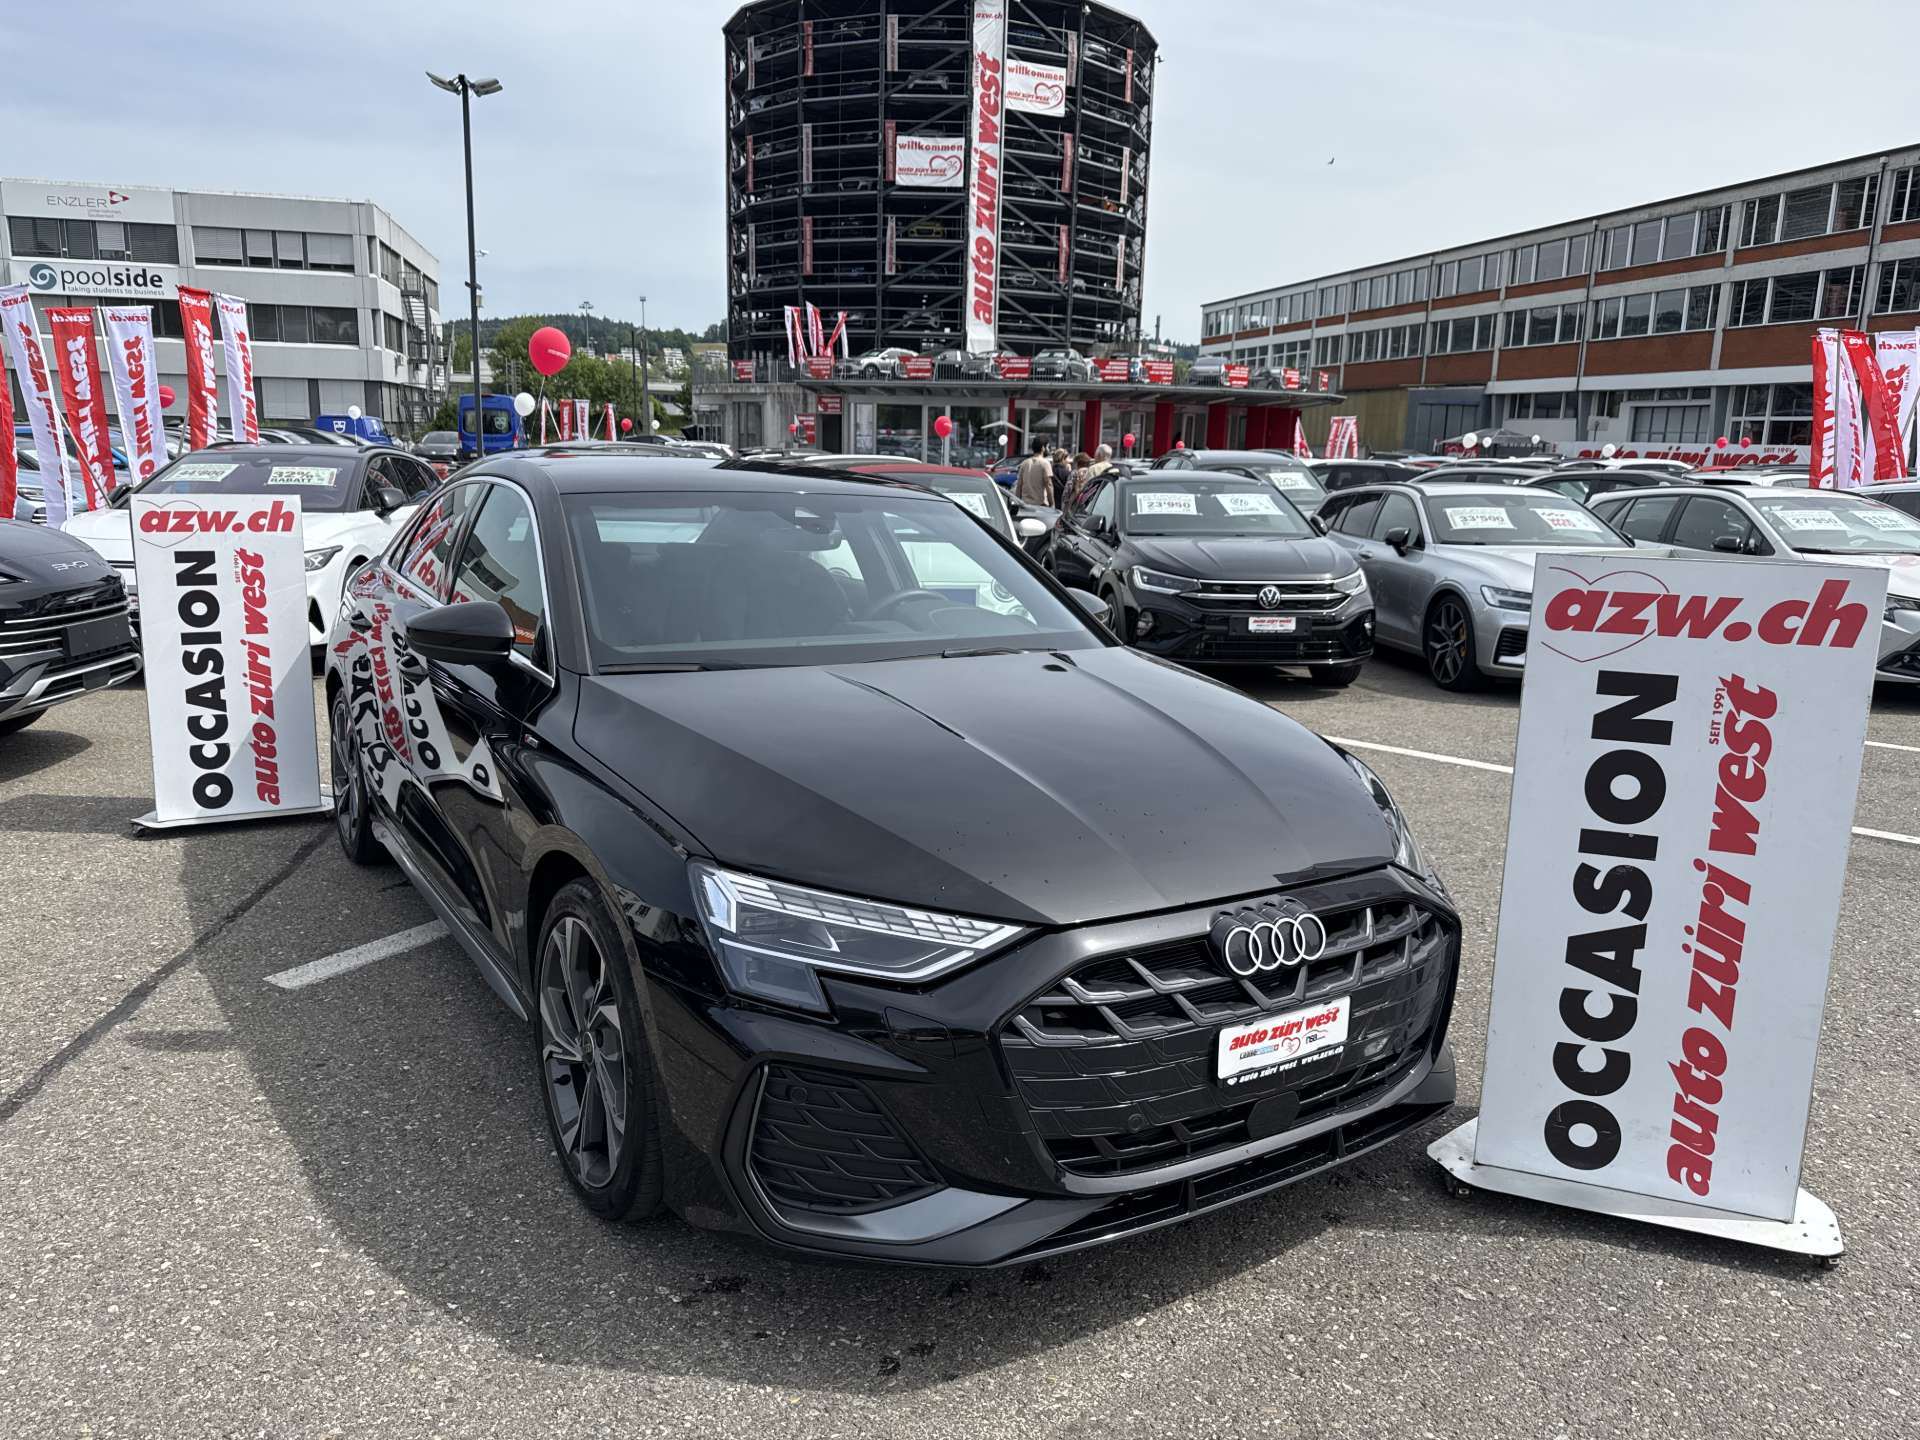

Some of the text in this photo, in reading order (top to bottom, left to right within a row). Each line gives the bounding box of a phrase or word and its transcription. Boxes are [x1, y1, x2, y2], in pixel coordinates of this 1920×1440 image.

[976, 11, 1003, 19] azw.ch
[1008, 65, 1064, 81] willkommen
[898, 141, 963, 151] willkommen
[47, 195, 108, 208] ENZLER
[970, 51, 1001, 325] auto züri west
[61, 266, 163, 291] poolside
[67, 285, 91, 294] taking
[92, 286, 123, 294] students
[134, 288, 165, 296] business
[139, 500, 295, 533] azw.ch
[1545, 579, 1869, 649] azw.ch
[173, 550, 234, 810] OCCASION
[233, 547, 281, 806] auto züri west
[1708, 687, 1726, 745] SEIT 1991
[1543, 669, 1680, 1172] OCCASION
[1666, 672, 1779, 1198] auto züri west
[1229, 1007, 1340, 1051] auto züri west
[1239, 1072, 1259, 1083] auto
[1280, 1060, 1298, 1071] west
